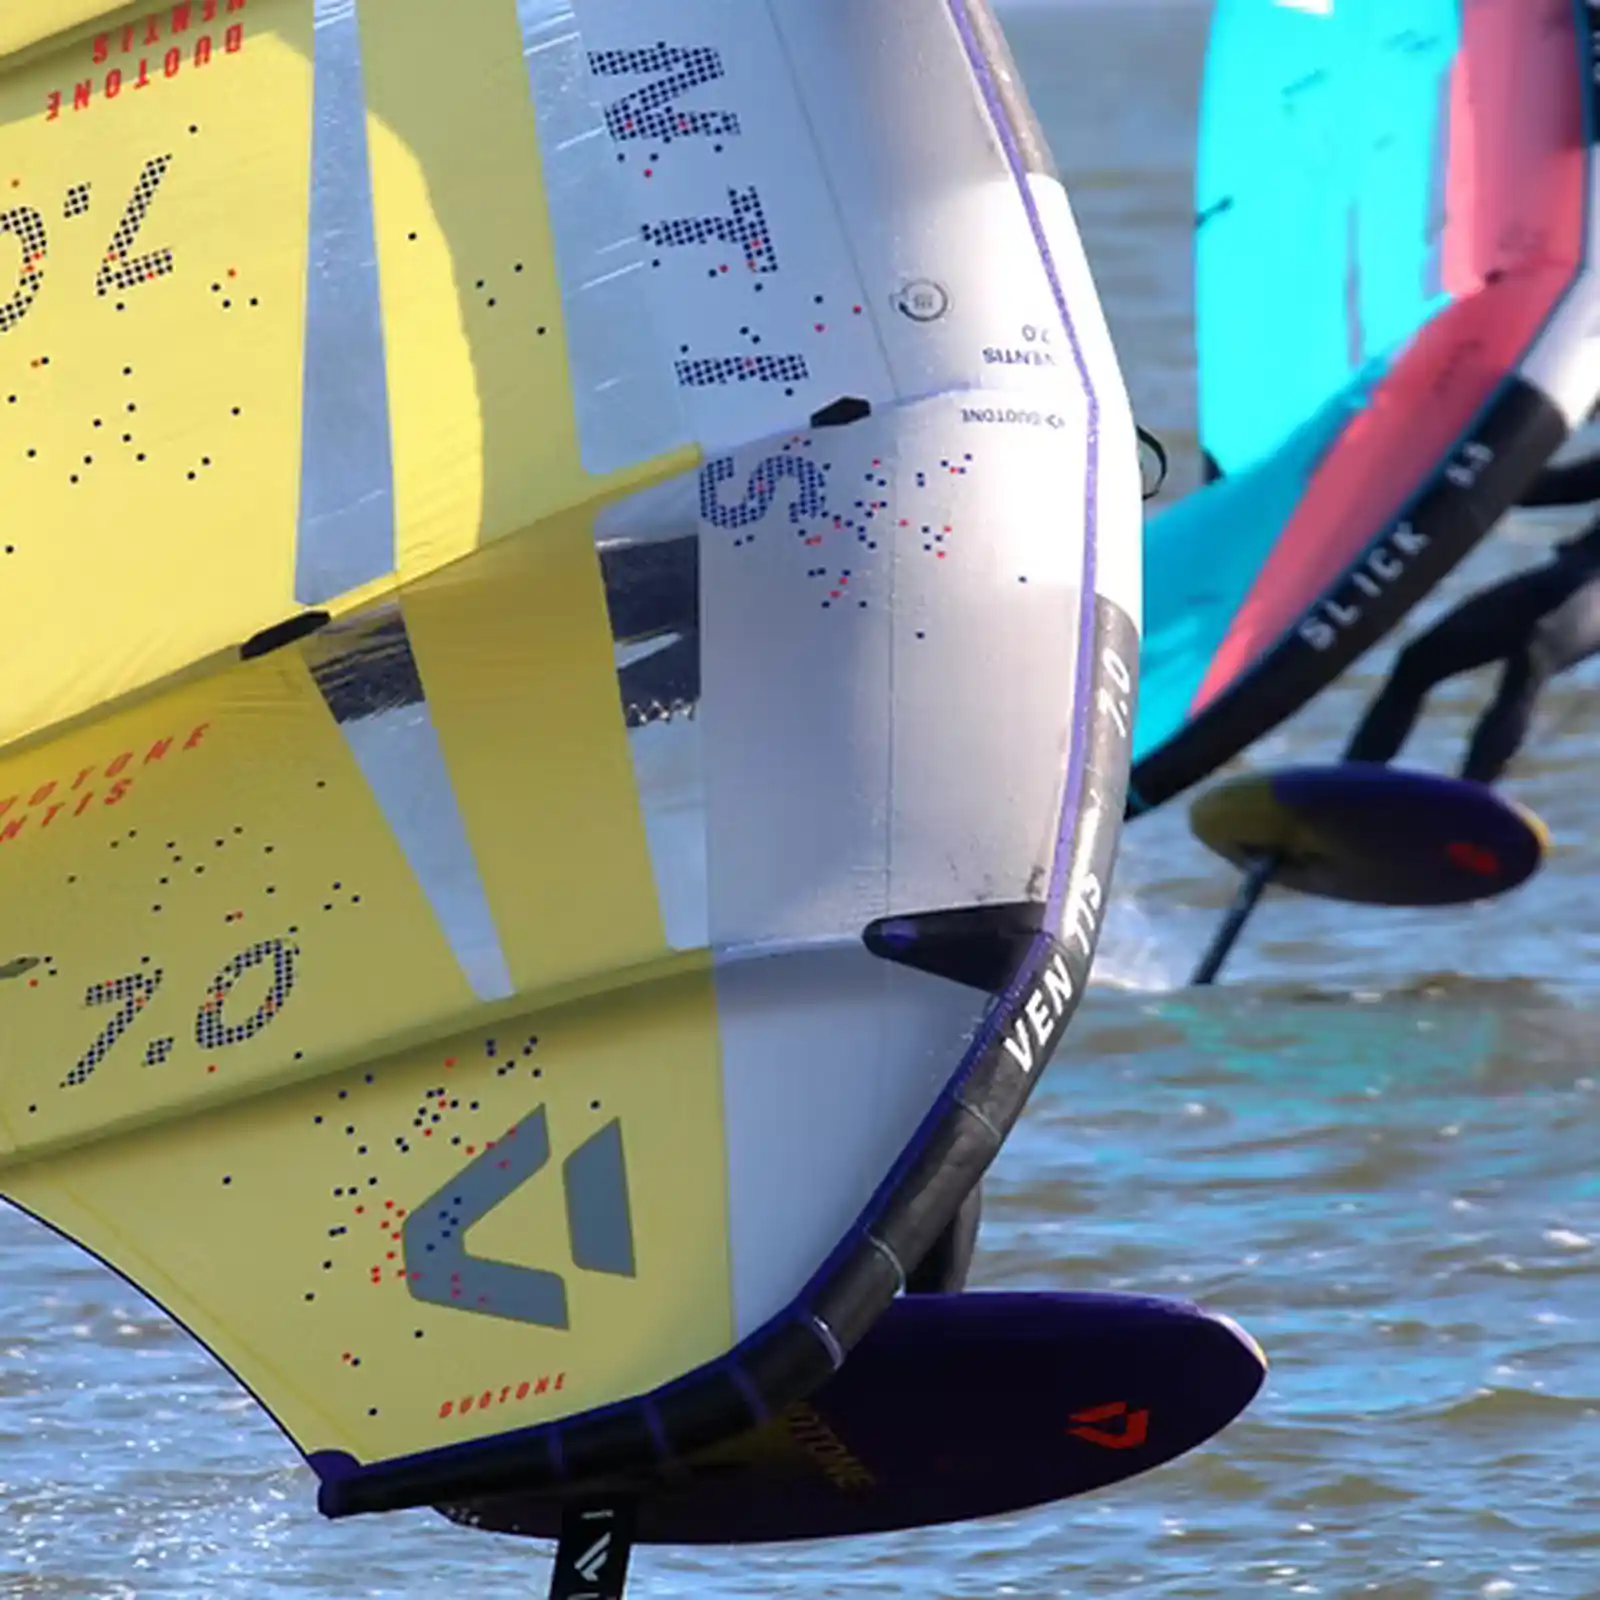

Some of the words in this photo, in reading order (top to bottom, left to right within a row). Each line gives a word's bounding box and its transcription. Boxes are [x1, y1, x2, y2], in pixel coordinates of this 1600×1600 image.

[46, 24, 243, 121] DUOTONE
[1301, 521, 1431, 650] SLICK
[1097, 646, 1130, 737] 7.0
[58, 936, 300, 1089] 7.0
[438, 1372, 565, 1419] DUOTONE
